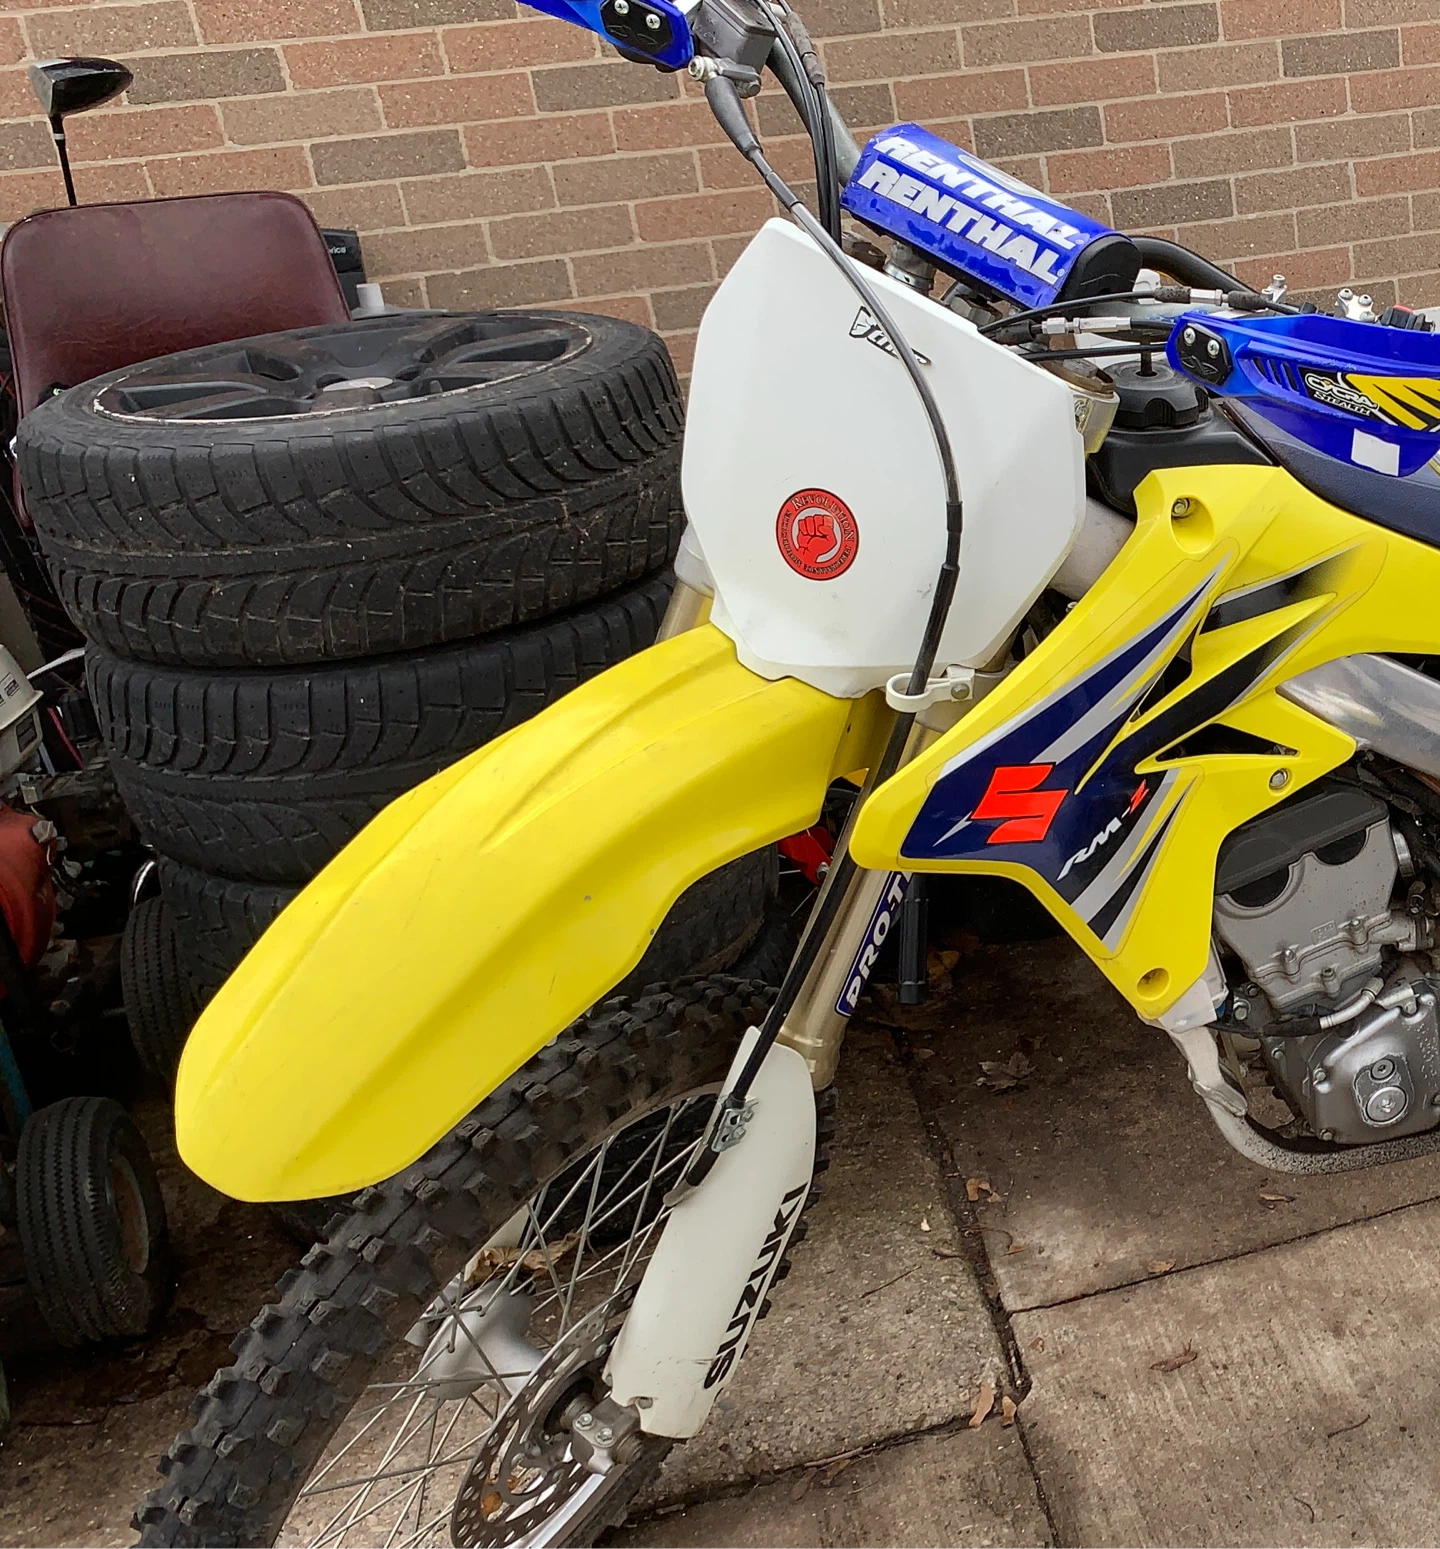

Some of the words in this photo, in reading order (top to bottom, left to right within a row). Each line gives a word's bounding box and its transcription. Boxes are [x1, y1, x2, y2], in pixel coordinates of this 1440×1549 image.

[857, 160, 1060, 285] RENTHAL
[872, 136, 1079, 250] RENTHAL
[1314, 391, 1371, 416] STEALTH
[1056, 780, 1150, 882] RM-Z
[703, 1182, 808, 1390] SUZUKI
